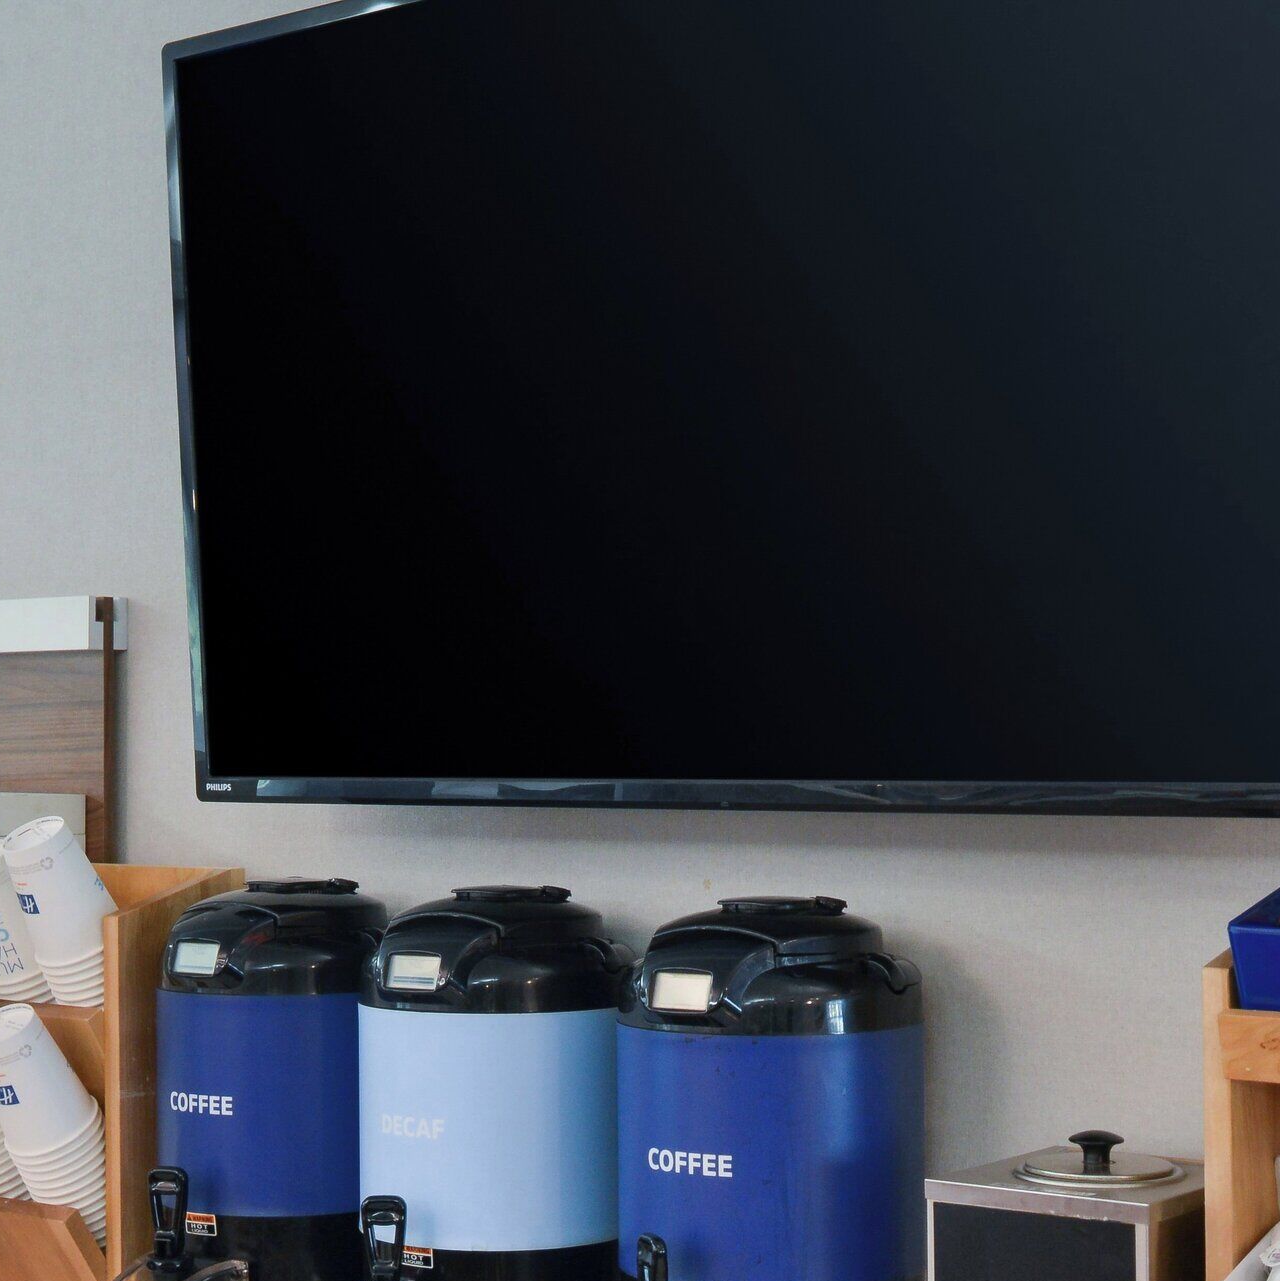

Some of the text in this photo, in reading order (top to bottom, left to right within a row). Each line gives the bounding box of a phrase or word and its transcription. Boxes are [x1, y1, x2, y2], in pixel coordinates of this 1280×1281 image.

[206, 783, 232, 791] PHILIPS
[170, 1091, 233, 1116] COFFEE
[381, 1113, 445, 1140] DECAF
[648, 1147, 733, 1177] COFFEE
[404, 1253, 424, 1261] HOT
